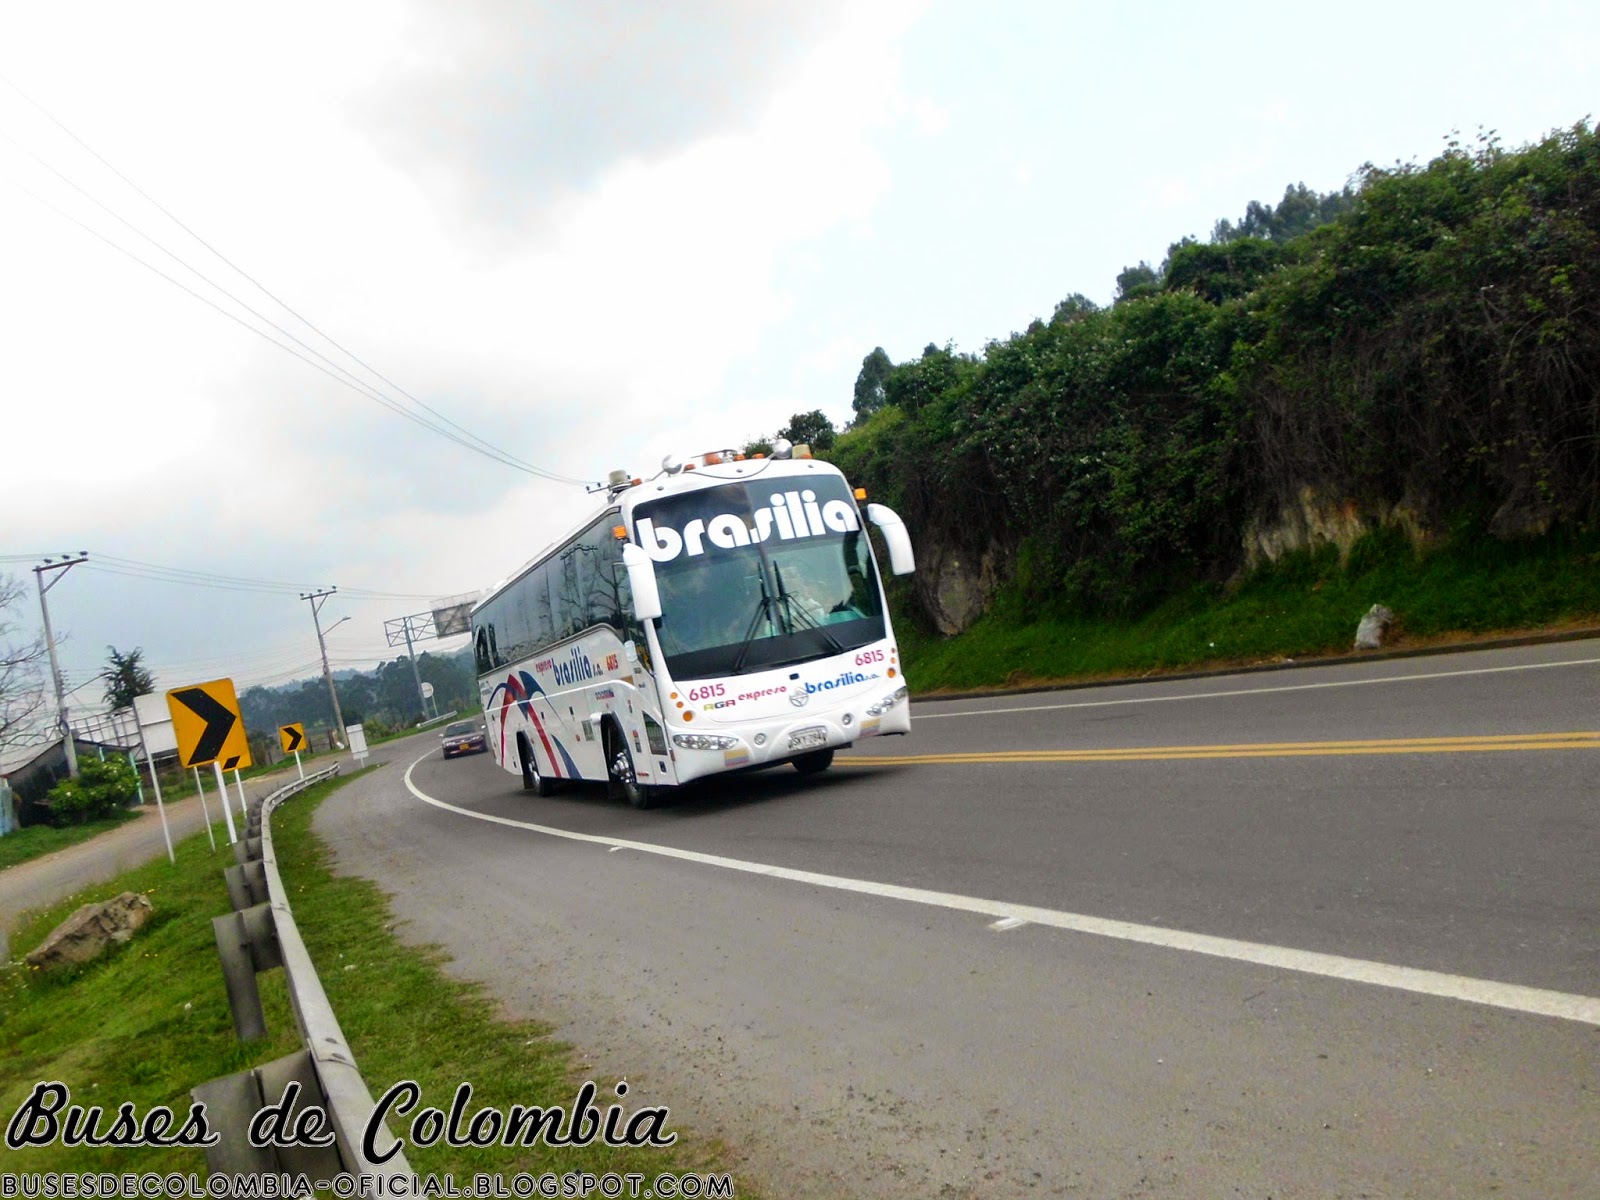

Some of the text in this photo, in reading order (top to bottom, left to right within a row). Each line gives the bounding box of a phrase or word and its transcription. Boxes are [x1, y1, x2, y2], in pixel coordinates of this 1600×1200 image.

[636, 490, 860, 562] brasilia
[551, 646, 593, 686] brasilia
[854, 649, 885, 667] 6815
[689, 683, 726, 702] 6815
[738, 685, 787, 701] expreso
[804, 671, 865, 694] brasilia
[703, 699, 736, 712] AGA
